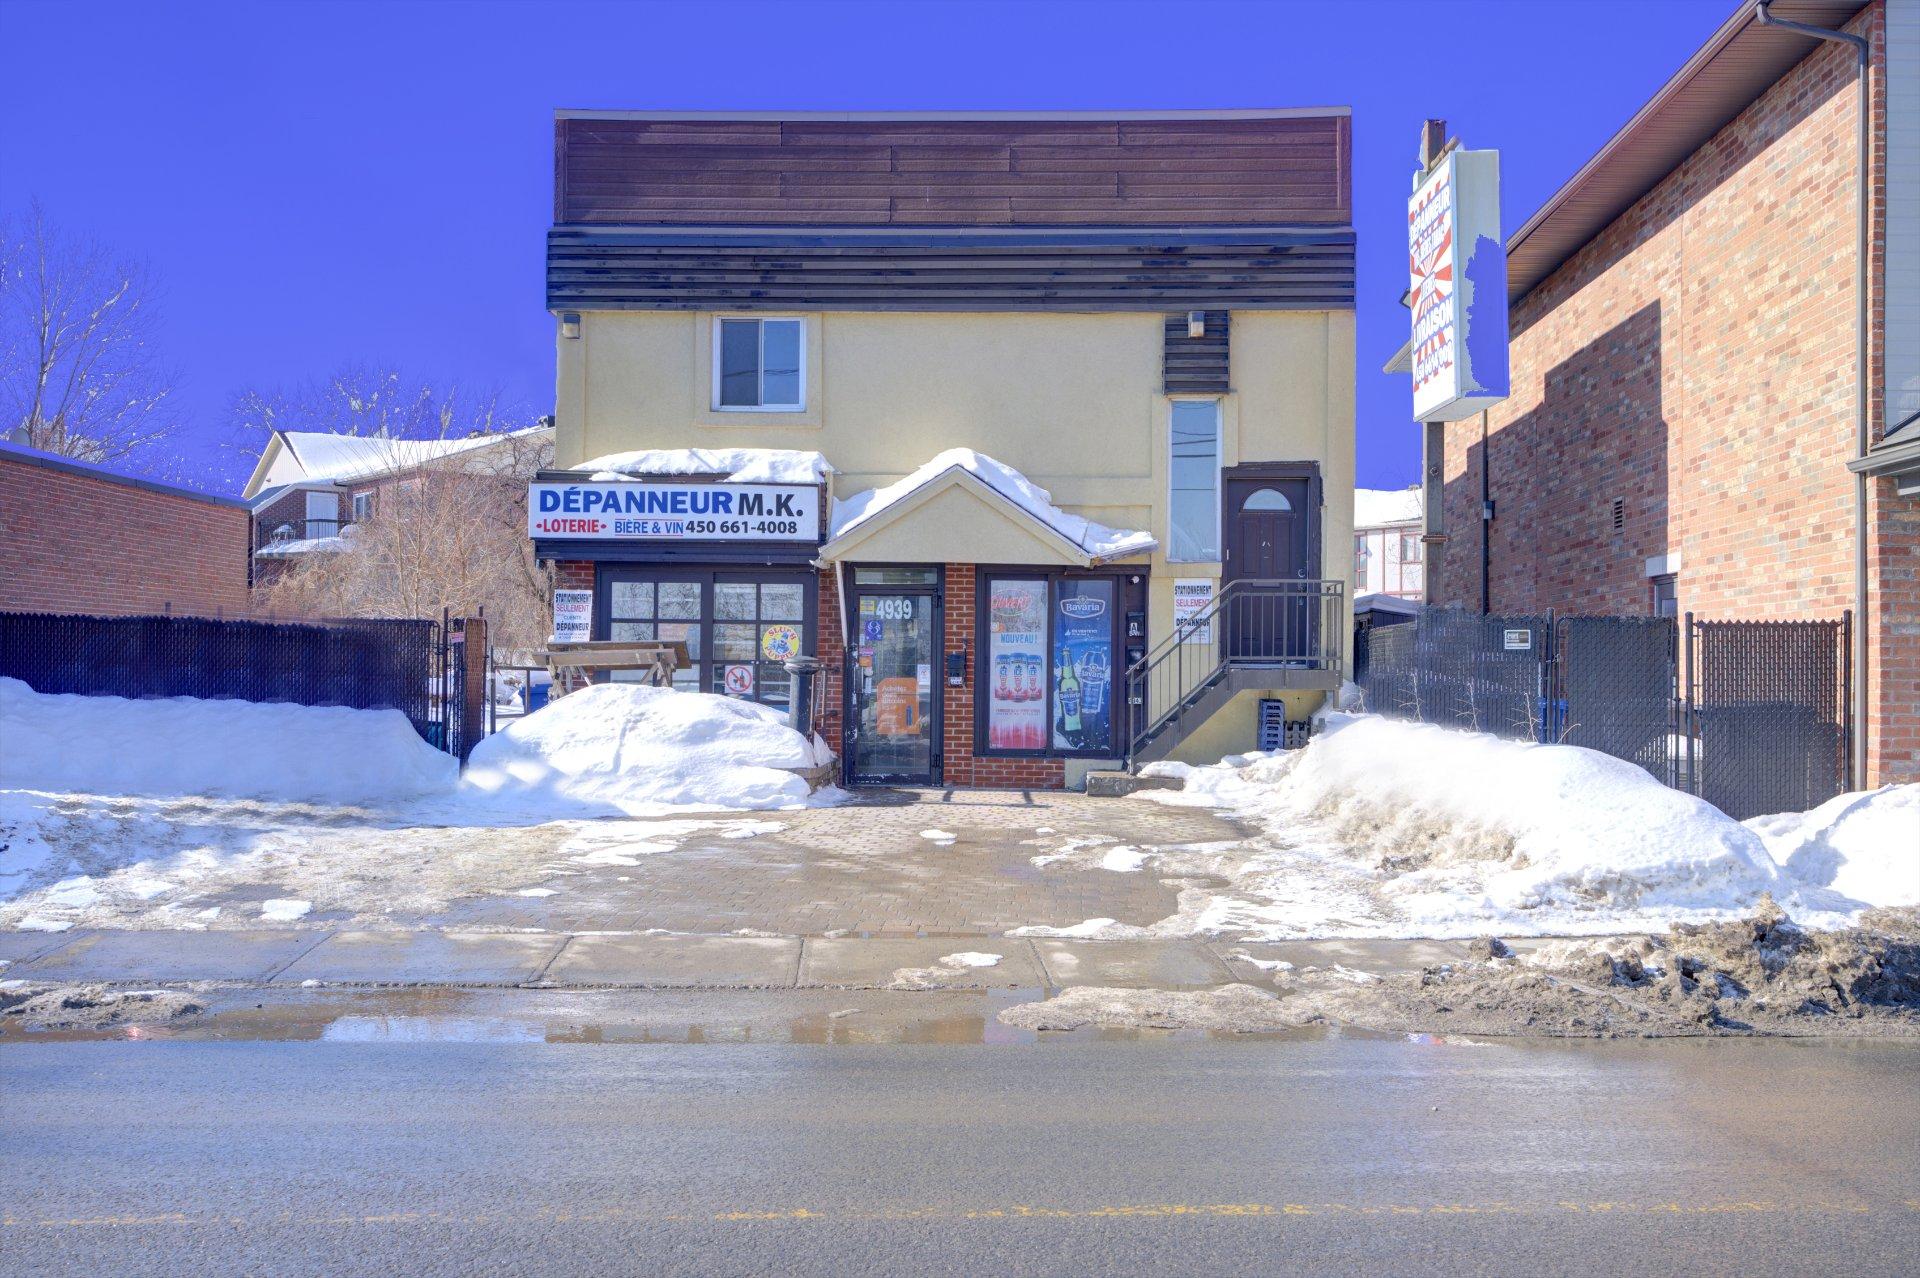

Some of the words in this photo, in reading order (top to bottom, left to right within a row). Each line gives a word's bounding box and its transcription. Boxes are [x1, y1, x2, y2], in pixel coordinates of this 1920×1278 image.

[539, 486, 733, 514] DÉPANNEUR
[738, 493, 804, 517] M.K.
[543, 518, 599, 533] LOTERIE
[615, 517, 648, 534] BIÈRE
[651, 522, 661, 534] &
[665, 521, 683, 534] VIN
[686, 520, 715, 533] 450
[720, 520, 797, 534] 661-4008
[1175, 585, 1212, 595] STATIONNEMENT
[555, 593, 592, 603] STATIONNEMENT
[556, 604, 590, 612] SEULEMENT
[876, 600, 912, 619] 4939
[1066, 603, 1100, 612] Bavaria
[556, 620, 590, 630] DÉPANNEUR
